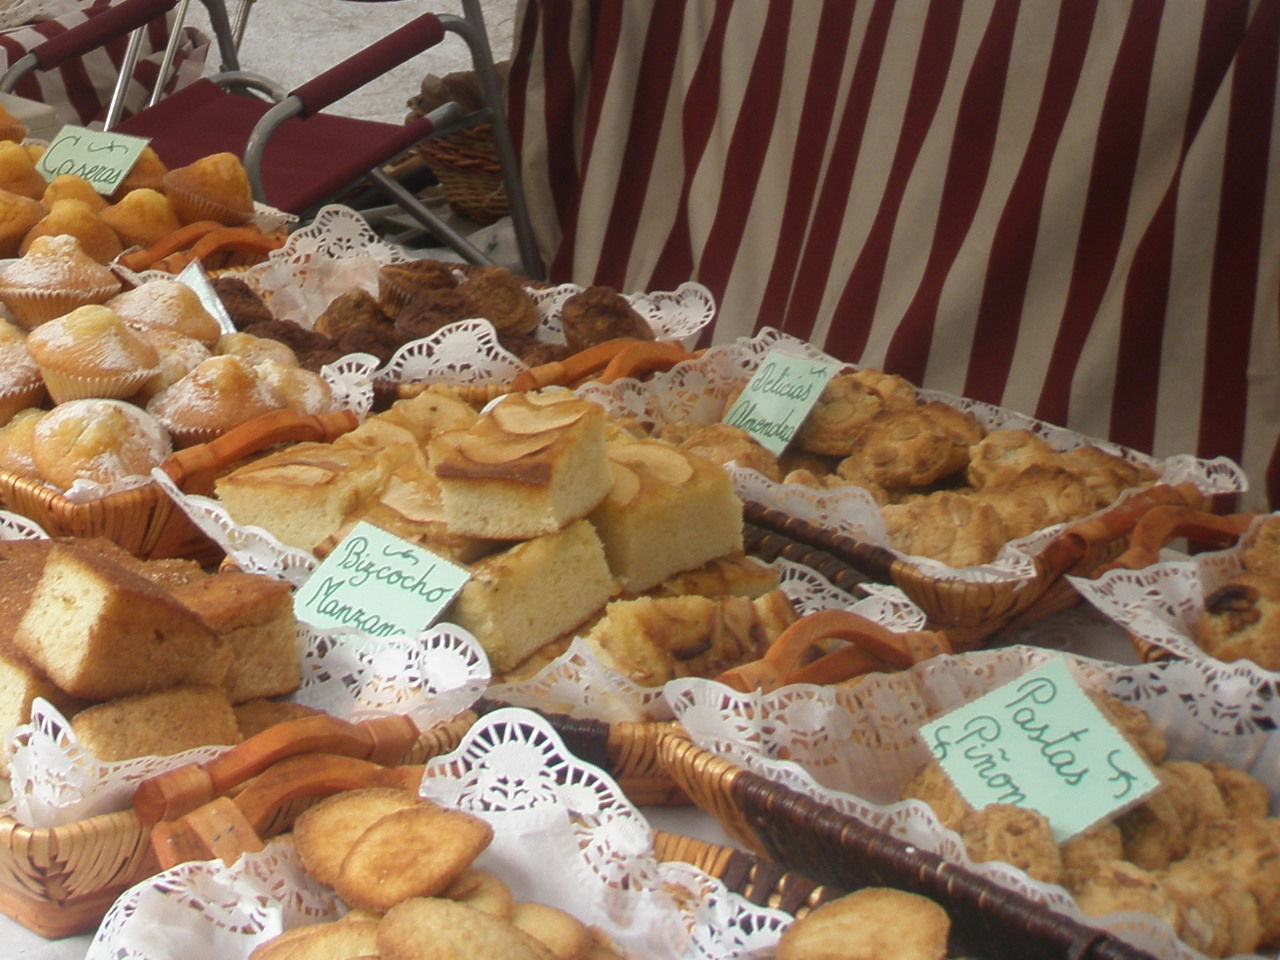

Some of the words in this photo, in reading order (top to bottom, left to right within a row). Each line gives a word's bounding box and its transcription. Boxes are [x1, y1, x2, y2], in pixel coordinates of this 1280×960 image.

[751, 361, 814, 402] Delicias
[336, 536, 454, 603] Bizcocho
[1005, 676, 1090, 787] Pastas
